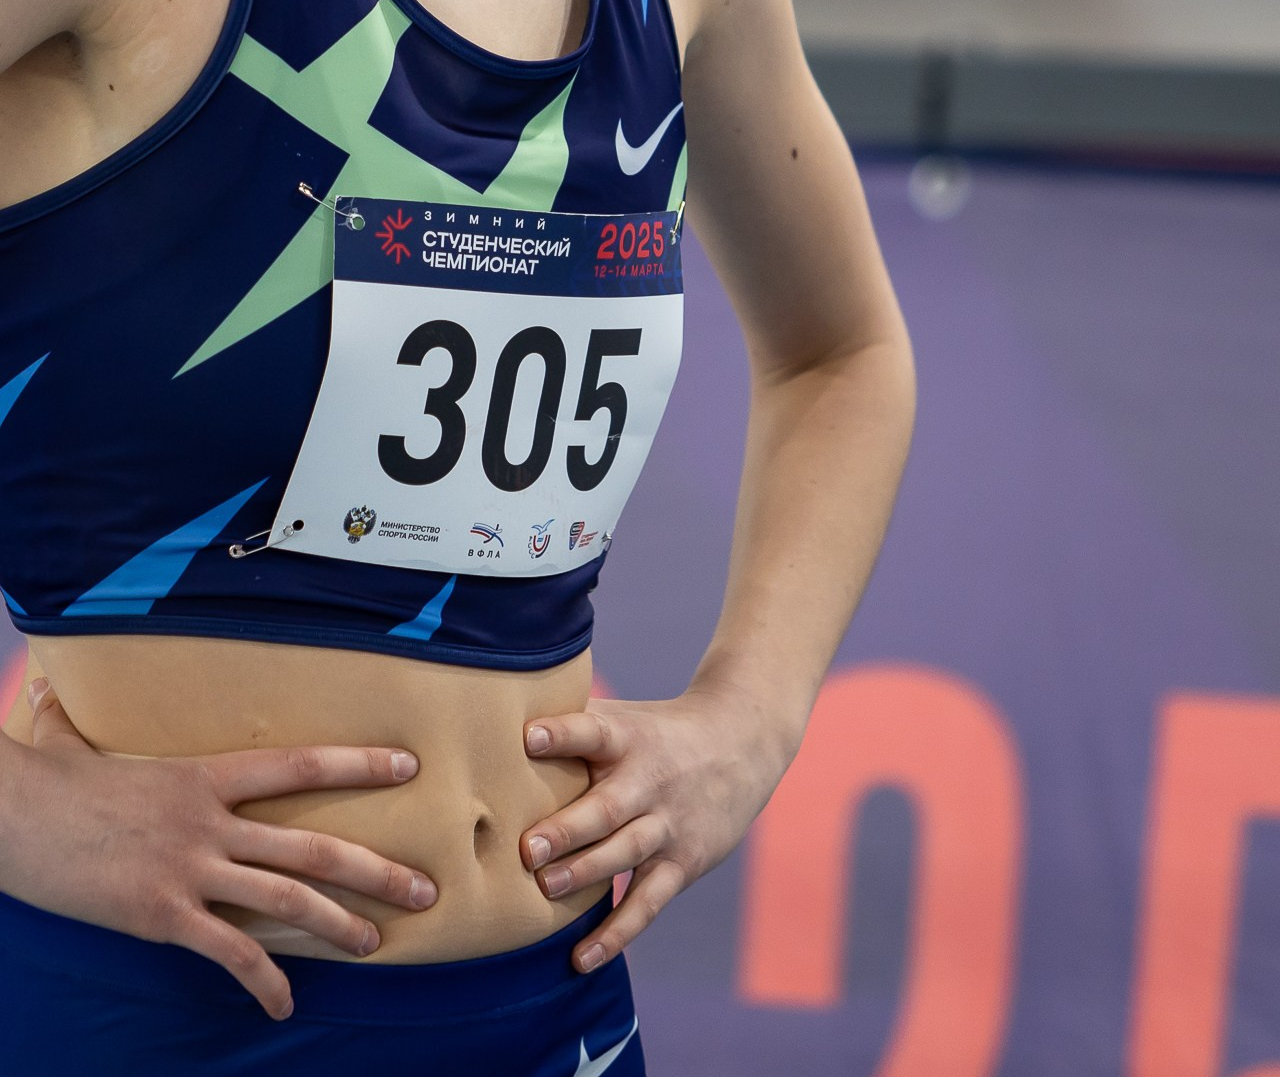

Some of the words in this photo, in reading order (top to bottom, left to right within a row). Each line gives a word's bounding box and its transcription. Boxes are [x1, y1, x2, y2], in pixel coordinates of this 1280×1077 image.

[424, 210, 546, 230] ЗИМНИЙ
[422, 230, 571, 257] СТУДЕНЧЕСКИЙ
[597, 221, 664, 260] 2025
[422, 250, 539, 275] ЧЕМПИОНАТ
[630, 263, 664, 277] МАРТА
[377, 319, 643, 492] 305
[378, 530, 407, 540] СПОРТА
[408, 532, 439, 543] РОССИИ
[380, 521, 440, 534] МИНИСТЕРСТВО
[467, 549, 501, 559] ВФЛА
